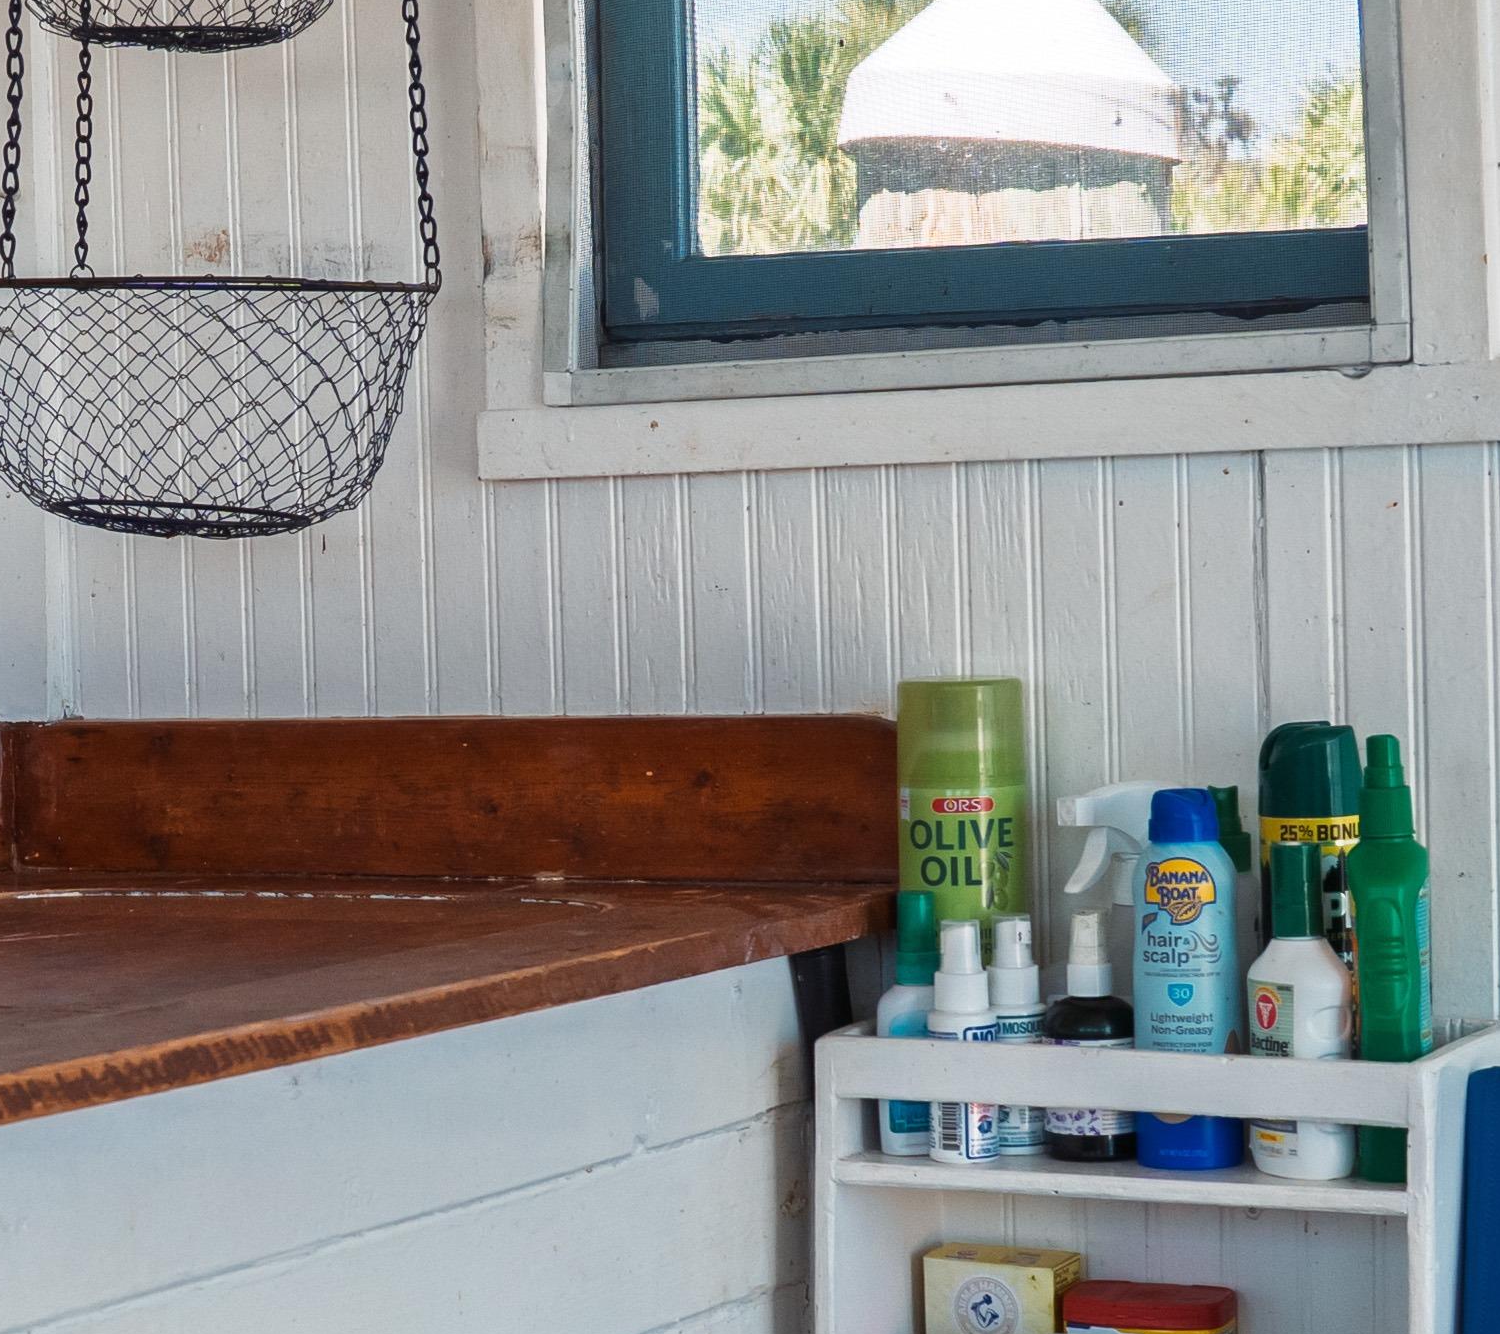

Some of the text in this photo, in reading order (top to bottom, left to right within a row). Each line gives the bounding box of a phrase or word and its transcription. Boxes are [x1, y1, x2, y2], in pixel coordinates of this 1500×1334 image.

[943, 799, 983, 812] ORS
[910, 817, 1014, 850] OLIVE
[1280, 822, 1361, 841] 25% BONU
[920, 856, 983, 887] OIL
[1146, 865, 1209, 886] BANANA
[1157, 886, 1199, 907] BOAT
[1147, 931, 1190, 947] hair &
[1143, 948, 1190, 967] scalp
[1171, 988, 1190, 999] 30
[1150, 1012, 1214, 1024] Lightweight
[1151, 1025, 1214, 1036] Non-Greasy
